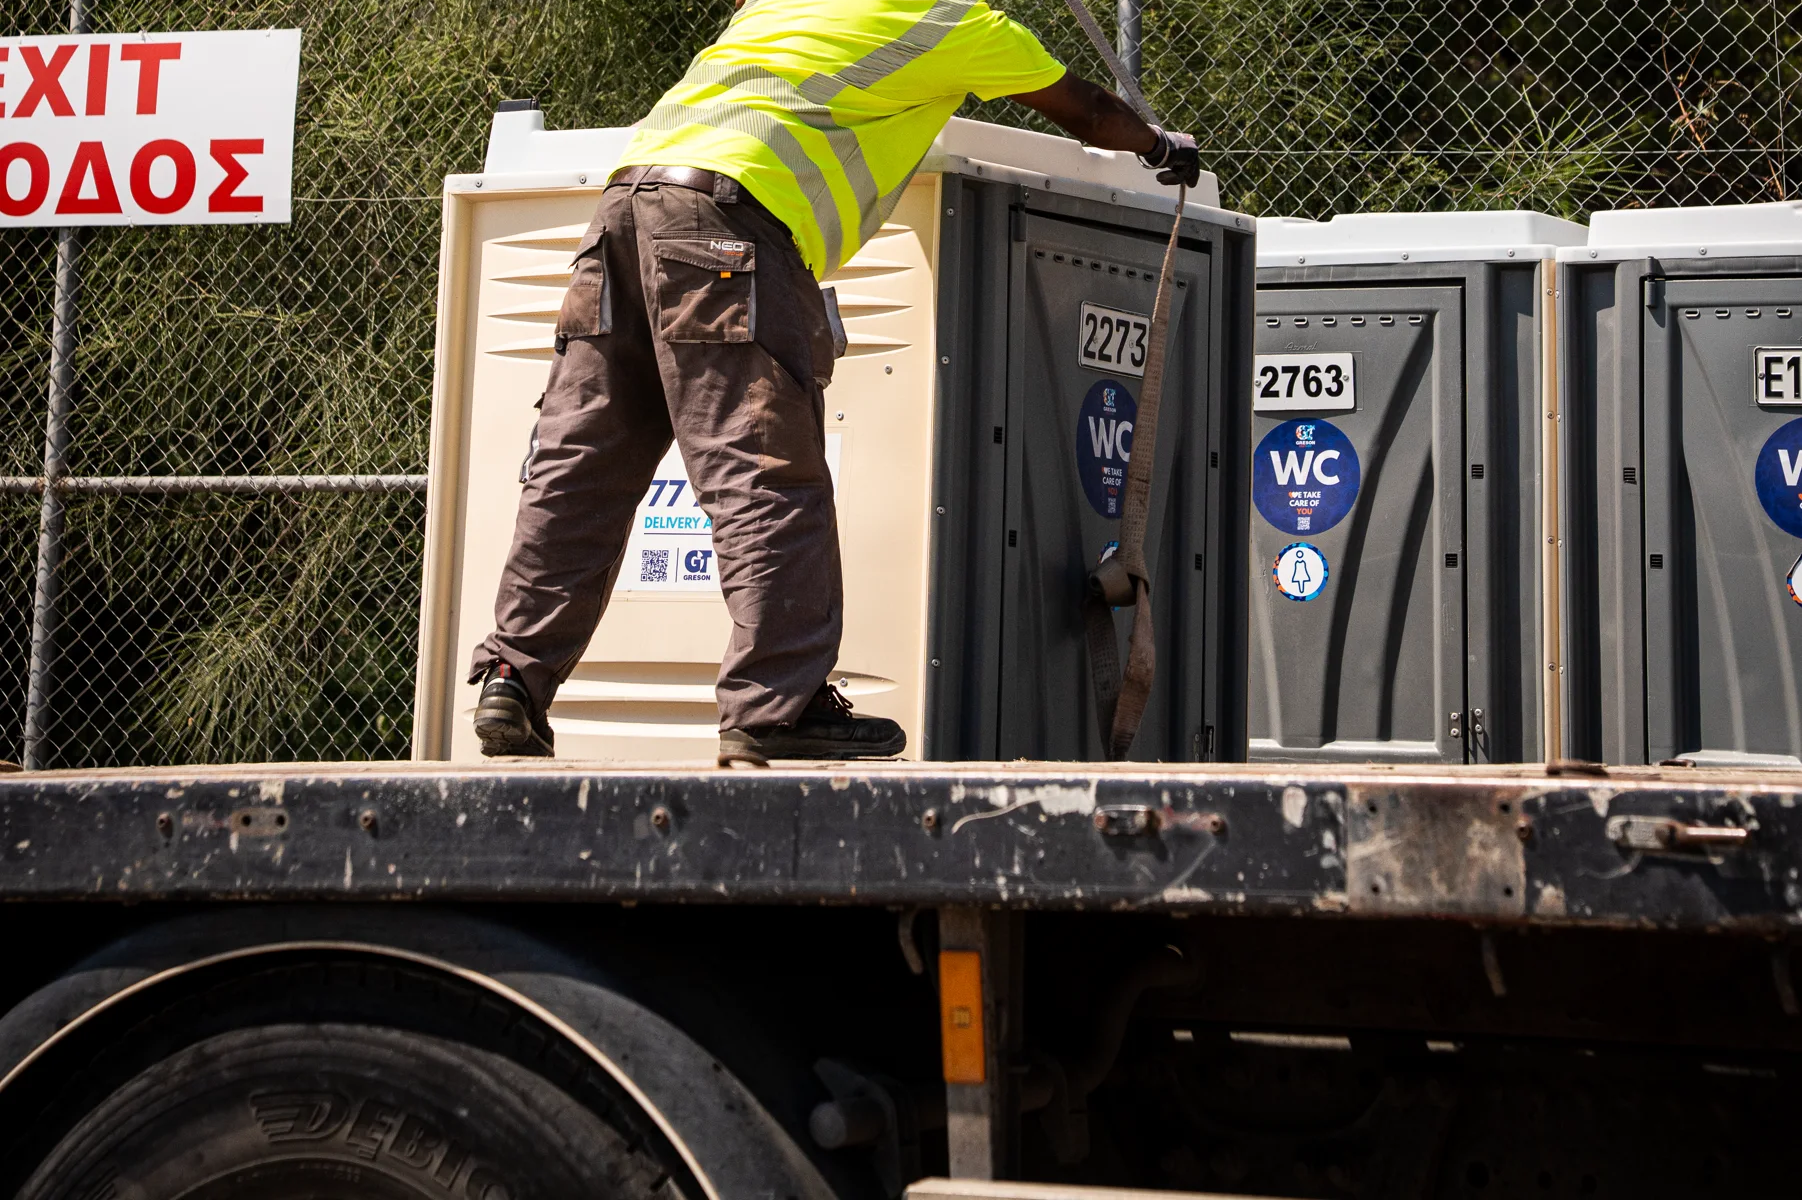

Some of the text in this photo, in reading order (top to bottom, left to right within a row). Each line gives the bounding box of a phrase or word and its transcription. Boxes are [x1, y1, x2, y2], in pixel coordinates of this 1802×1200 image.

[0, 42, 182, 118] XIT
[710, 240, 744, 251] NEO
[1083, 313, 1147, 367] 2273
[1259, 364, 1345, 398] 2763
[1764, 356, 1801, 398] E1
[1088, 415, 1133, 462] WC
[1111, 468, 1122, 477] TAKE
[1269, 450, 1340, 486] WC
[1102, 476, 1122, 486] CARE OF
[1107, 487, 1118, 496] YOU
[1289, 499, 1320, 507] CARE OF
[644, 516, 701, 529] DELIVERY
[684, 550, 713, 574] GT
